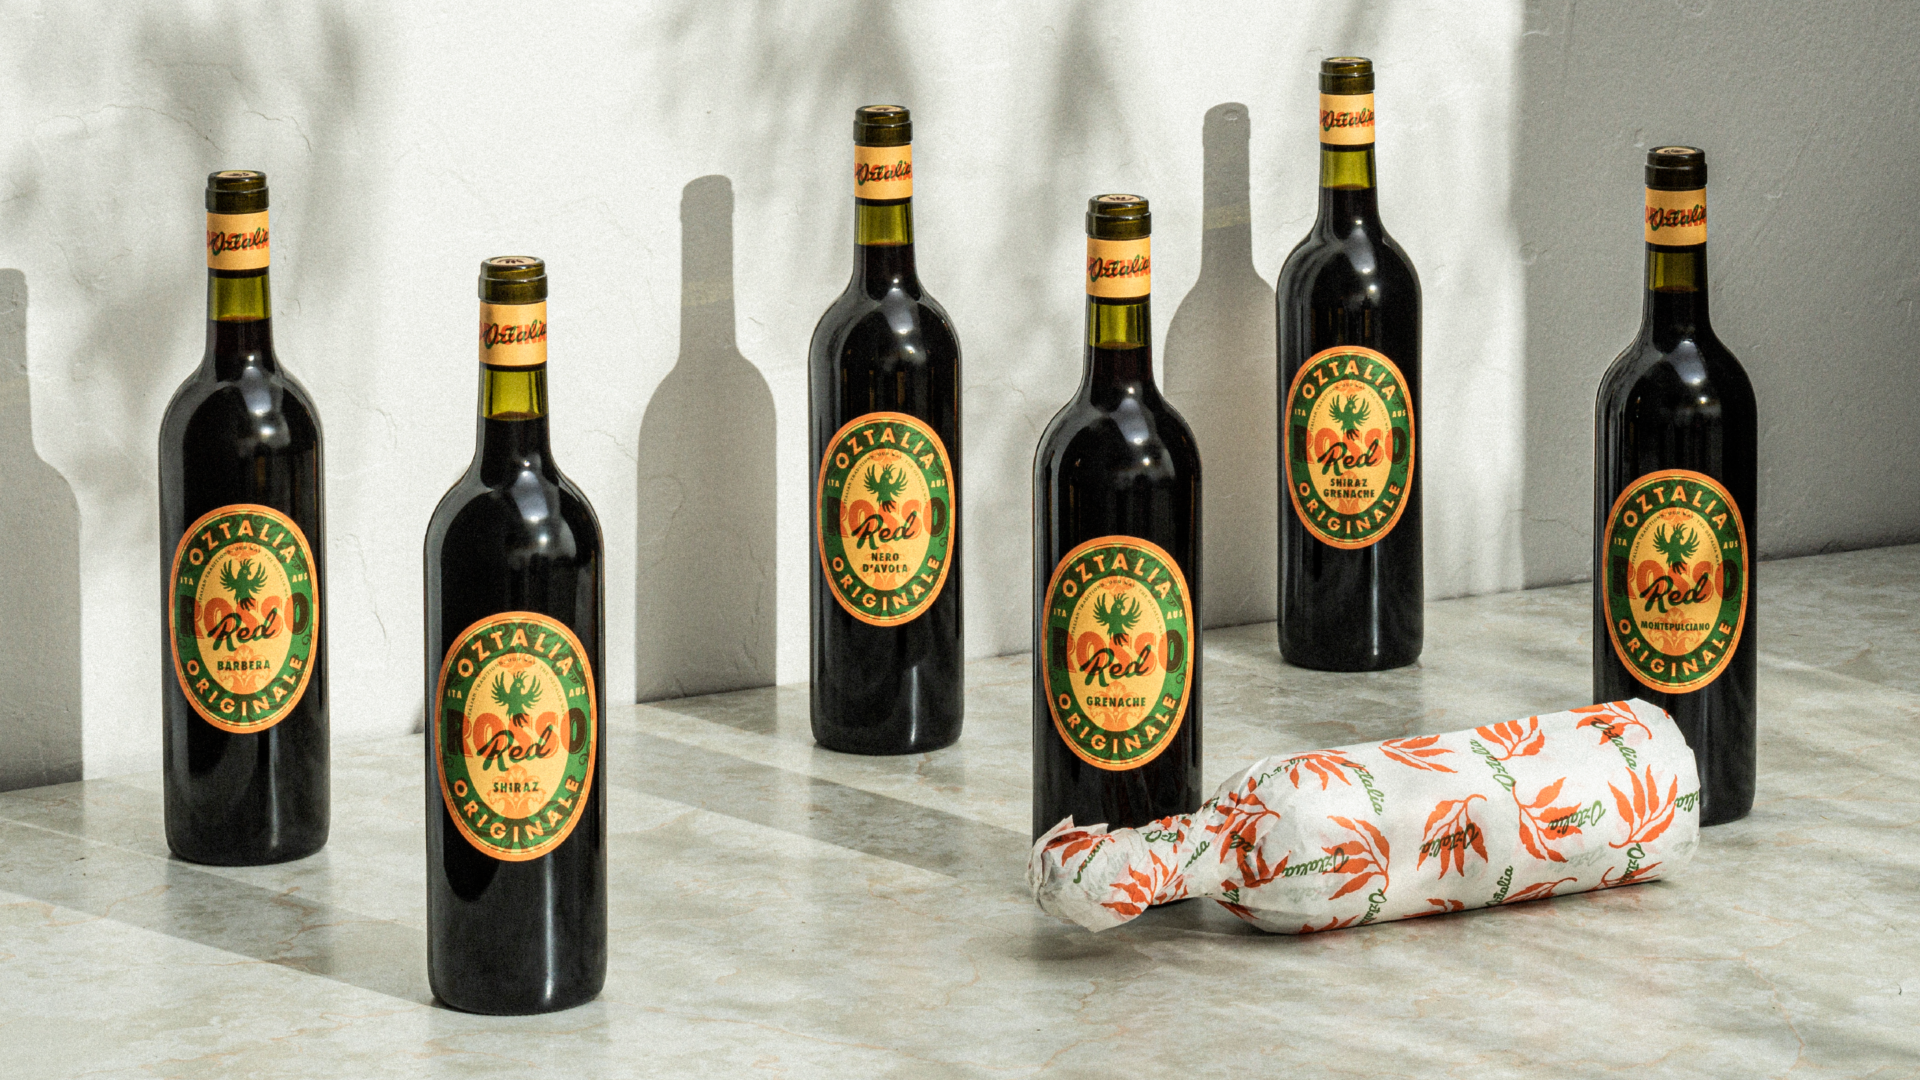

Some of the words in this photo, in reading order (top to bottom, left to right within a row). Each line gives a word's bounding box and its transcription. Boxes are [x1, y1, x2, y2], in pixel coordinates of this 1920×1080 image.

[1322, 107, 1374, 132] Oztalia
[856, 160, 911, 186] Oztalia
[209, 227, 268, 256] Oztalia
[1088, 254, 1150, 282] Oztalia
[482, 319, 546, 349] Oztalia
[1302, 360, 1396, 401] OZTALIA
[1294, 408, 1306, 416] ITA
[1392, 410, 1406, 418] AUS
[836, 428, 935, 470] OZTALIA
[1293, 424, 1406, 467] ROSSO
[1317, 439, 1379, 476] Red
[827, 479, 840, 488] ITA
[931, 478, 946, 488] AUS
[1323, 489, 1375, 498] GRENACHE
[1330, 478, 1368, 487] SHIRAZ
[827, 496, 947, 540] ROSSO
[1299, 482, 1400, 533] ORIGINALE
[1624, 485, 1728, 531] OZTALIA
[189, 520, 296, 565] OZTALIA
[851, 511, 918, 550] Red
[1614, 537, 1627, 546] ITA
[1723, 540, 1738, 549] AUS
[862, 564, 908, 573] D'AVOLA
[871, 552, 899, 561] NERO
[181, 577, 194, 586] ITA
[292, 573, 308, 583] AUS
[832, 556, 940, 611] ORIGINALE
[1063, 553, 1172, 599] OZTALIA
[1613, 555, 1740, 604] ROSSO
[1640, 572, 1709, 613] Red
[180, 592, 310, 640] ROSSO
[207, 607, 278, 652] Red
[1053, 608, 1067, 618] ITA
[1167, 609, 1183, 619] AUS
[1641, 621, 1710, 631] MONTEPULCIANO
[458, 628, 574, 678] OZTALIA
[1053, 626, 1184, 676] ROSSO
[1619, 619, 1731, 676] ORIGINALE
[217, 660, 271, 671] BARBERA
[1079, 644, 1152, 687] Red
[187, 656, 303, 716] ORIGINALE
[448, 689, 462, 699] ITA
[569, 686, 586, 698] AUS
[1086, 696, 1146, 707] GRENACHE
[446, 707, 587, 759] ROSSO
[1059, 692, 1176, 754] ORIGINALE
[476, 724, 553, 772] Red
[1590, 717, 1638, 770] Oztalia
[1470, 738, 1518, 792] Oztalia
[493, 782, 539, 793] SHIRAZ
[454, 778, 580, 843] ORIGINALE
[1548, 800, 1606, 835] Oztalia
[1419, 822, 1479, 858] Oztalia
[1281, 847, 1349, 878] Oztalia
